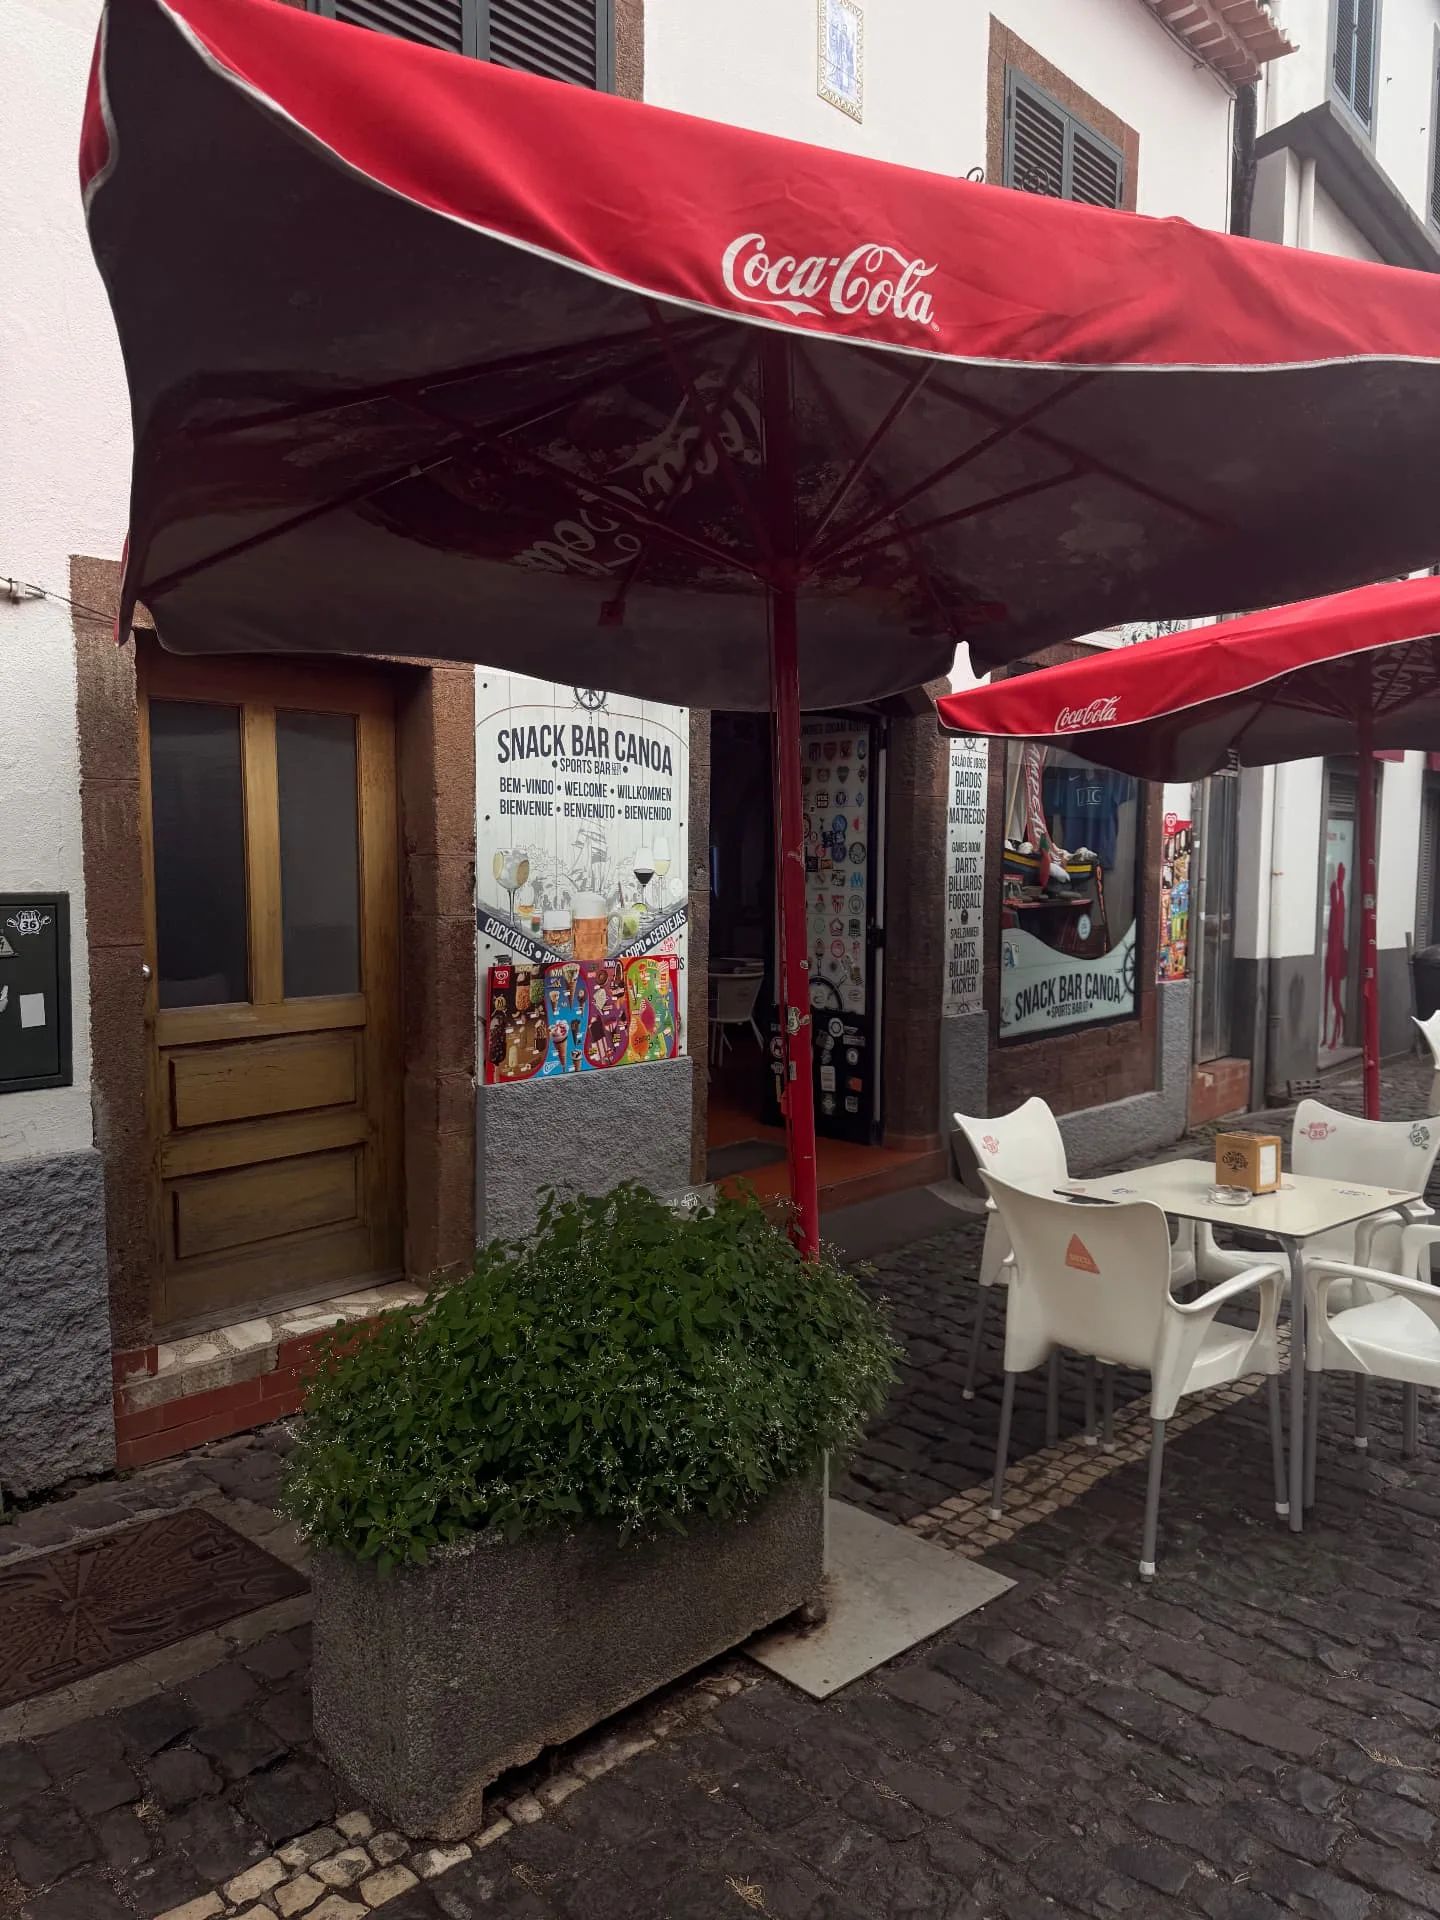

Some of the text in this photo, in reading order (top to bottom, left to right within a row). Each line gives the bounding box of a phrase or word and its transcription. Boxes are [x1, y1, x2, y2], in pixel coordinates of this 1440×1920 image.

[722, 232, 938, 325] Coca-Cola
[1055, 695, 1122, 732] Coca-Cola
[497, 724, 673, 776] SNACK BAR CANOA
[559, 758, 592, 774] SPORTS
[594, 760, 611, 775] BAR
[967, 757, 973, 768] DE
[955, 770, 982, 788] DARDOS
[499, 777, 672, 801] BEM-VINDO WELCOME WILLKOMMEN
[955, 789, 981, 806] BILHAR
[499, 799, 672, 821] BIENVENUE BENVENUTO BIENVENIDO
[949, 807, 986, 825] MATRECOS
[952, 841, 967, 852] GAMES
[955, 857, 977, 873] DARTS
[949, 875, 982, 892] BILLIARDS
[949, 893, 981, 910] FOOSBALL
[22, 920, 37, 930] 36
[650, 909, 687, 945] CERVEJAS
[484, 917, 535, 957] COCKTAILS
[954, 942, 976, 959] DARTS
[949, 959, 979, 978] BILLIARD
[951, 976, 977, 995] KICKER
[1015, 973, 1121, 1021] SNACK BAR CANOA
[1051, 1003, 1071, 1018] SPORTS
[1072, 1001, 1083, 1015] BAR
[1311, 1129, 1325, 1138] 36
